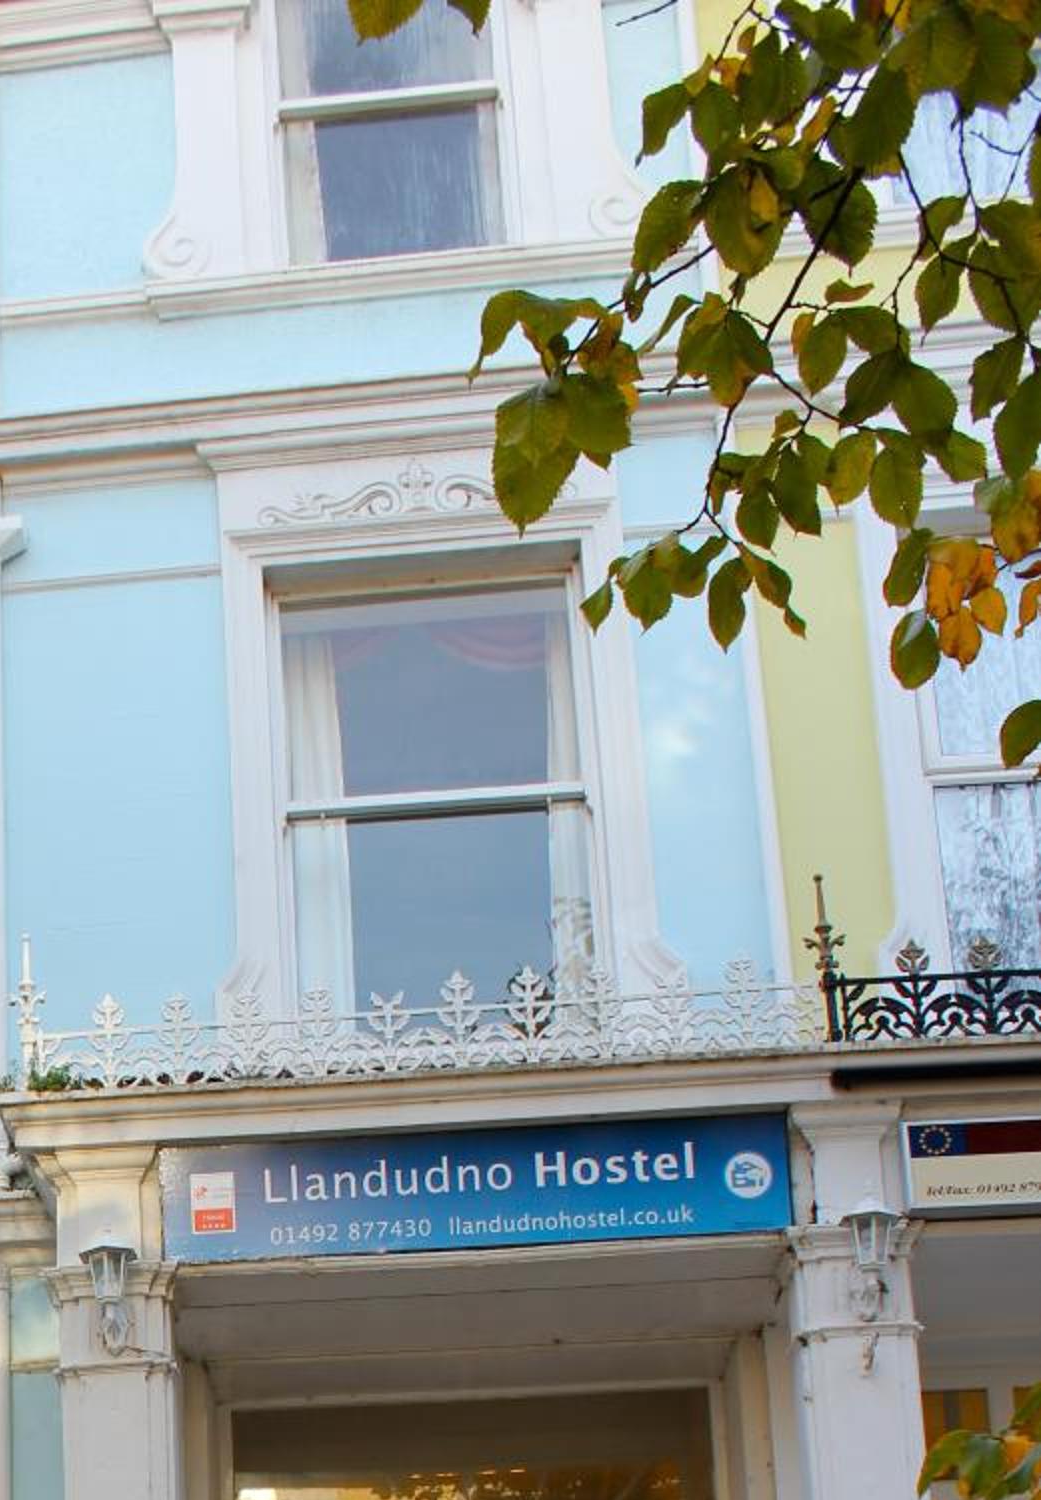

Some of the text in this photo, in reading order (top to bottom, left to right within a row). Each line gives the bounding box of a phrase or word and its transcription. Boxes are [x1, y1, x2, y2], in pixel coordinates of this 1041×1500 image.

[263, 1140, 696, 1204] Llandudno Hostel
[270, 1203, 695, 1246] 01492 877430 llandudnohostel.co.uk
